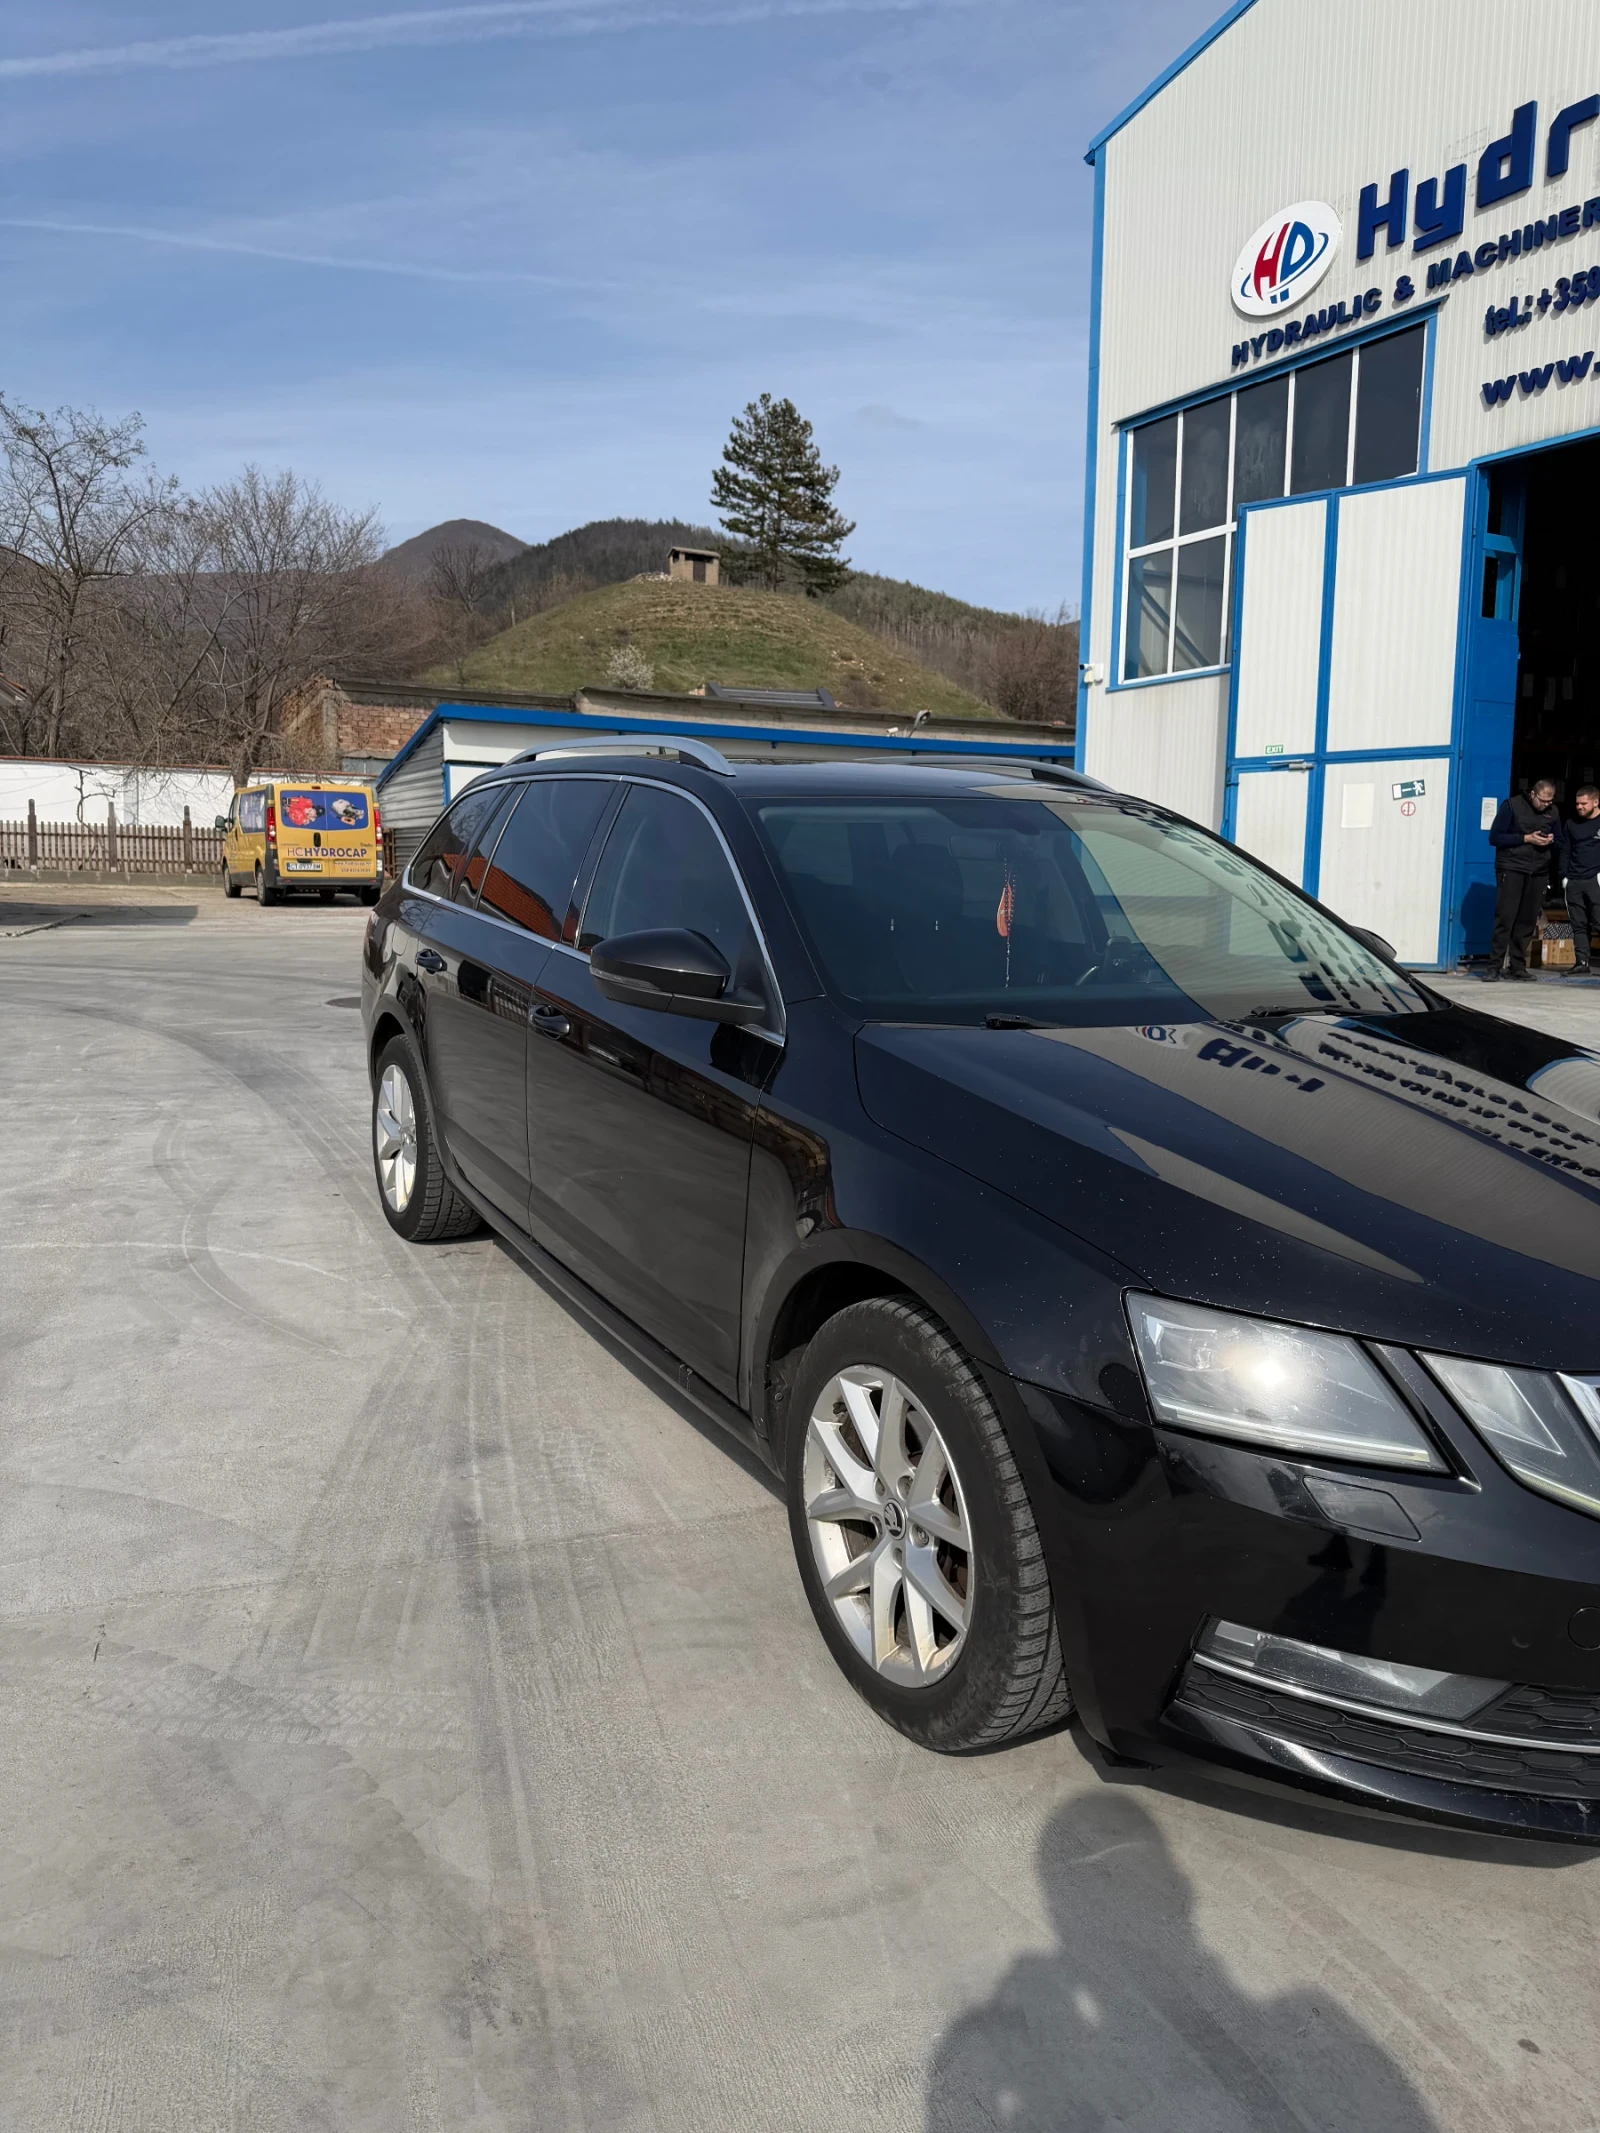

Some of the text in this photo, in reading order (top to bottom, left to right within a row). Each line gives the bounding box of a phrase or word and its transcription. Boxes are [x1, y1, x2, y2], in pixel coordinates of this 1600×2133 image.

[1356, 93, 1600, 260] Hydr
[1232, 196, 1600, 367] HYDRAULIC & MACHINER
[1266, 745, 1283, 754] EXIT
